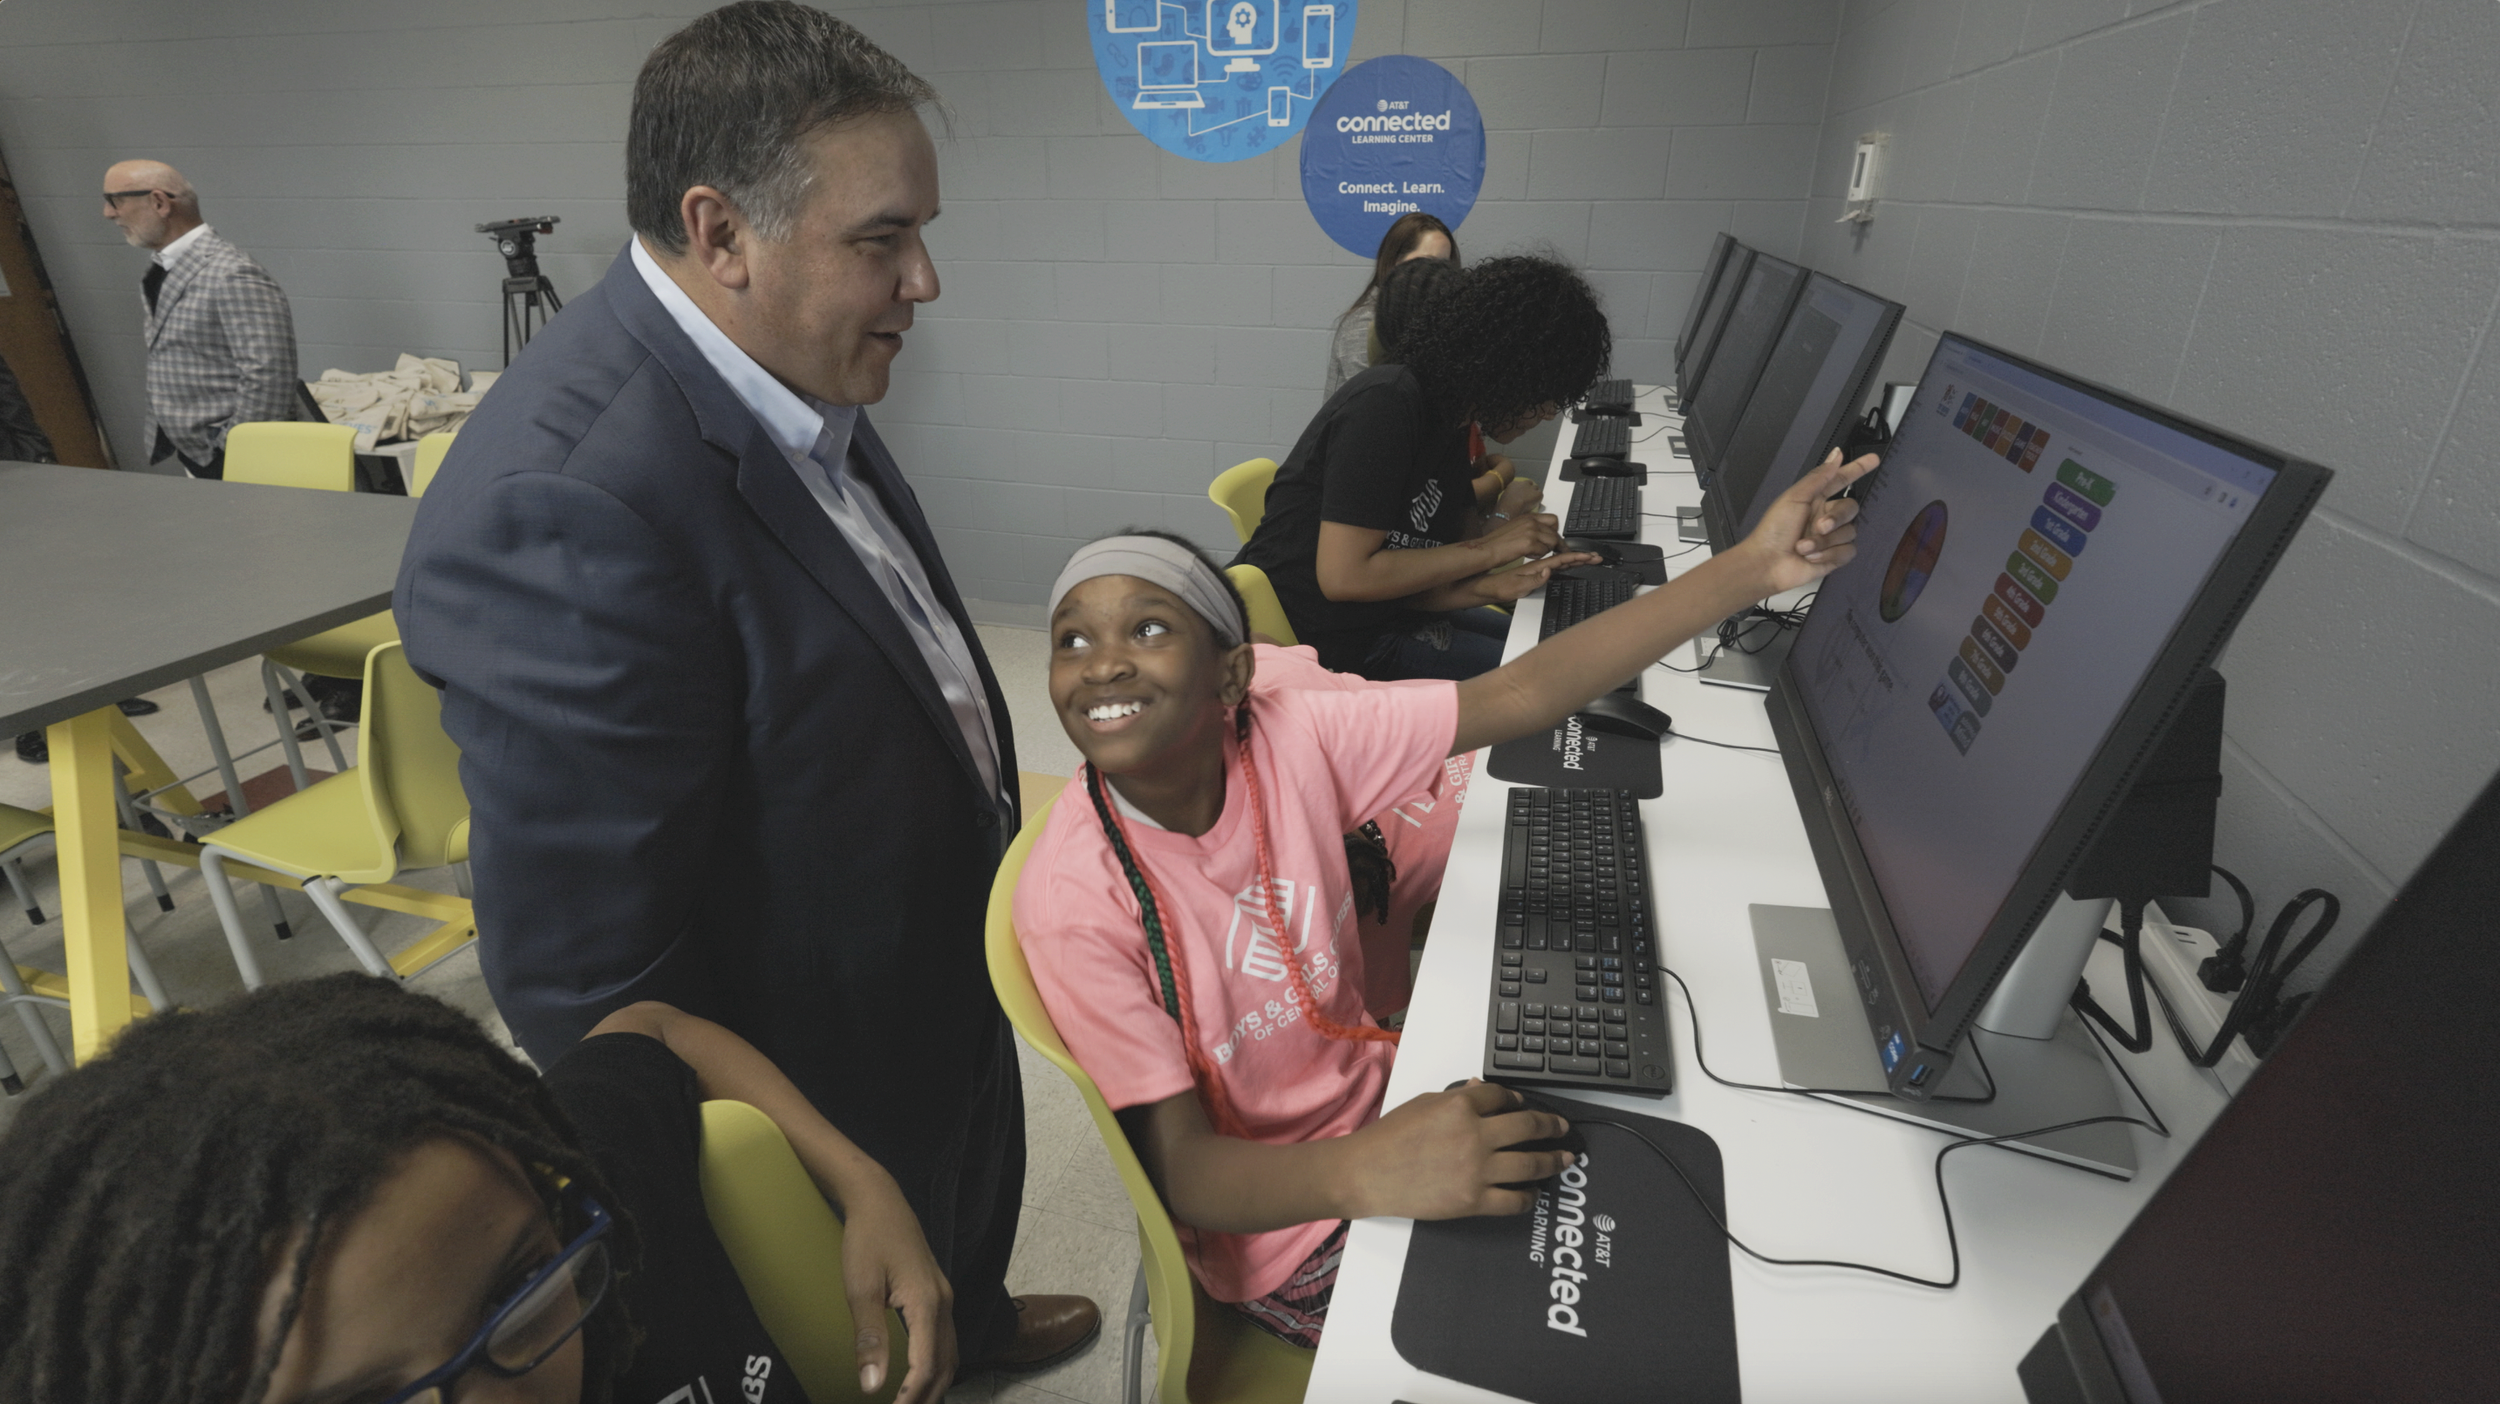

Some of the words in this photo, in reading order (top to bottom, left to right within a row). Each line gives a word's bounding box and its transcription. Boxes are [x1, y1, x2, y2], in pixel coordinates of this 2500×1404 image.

[1389, 101, 1409, 110] AT&T
[1336, 110, 1451, 133] connected
[1352, 135, 1396, 144] LEARNING
[1398, 134, 1434, 143] CENTER
[1338, 181, 1398, 194] Connect.
[1403, 181, 1445, 193] Learn.
[1364, 199, 1420, 216] Imagine.
[2053, 491, 2089, 520] Kindergarten
[2053, 523, 2070, 542] Grade
[1212, 1010, 1262, 1065] BOYS
[1264, 999, 1284, 1019] &
[1284, 952, 1328, 1004] GLS
[1254, 1023, 1275, 1041] OF
[1278, 979, 1329, 1028] CENAL
[1530, 1191, 1550, 1263] LEARNING
[1595, 1232, 1611, 1268] AT&T
